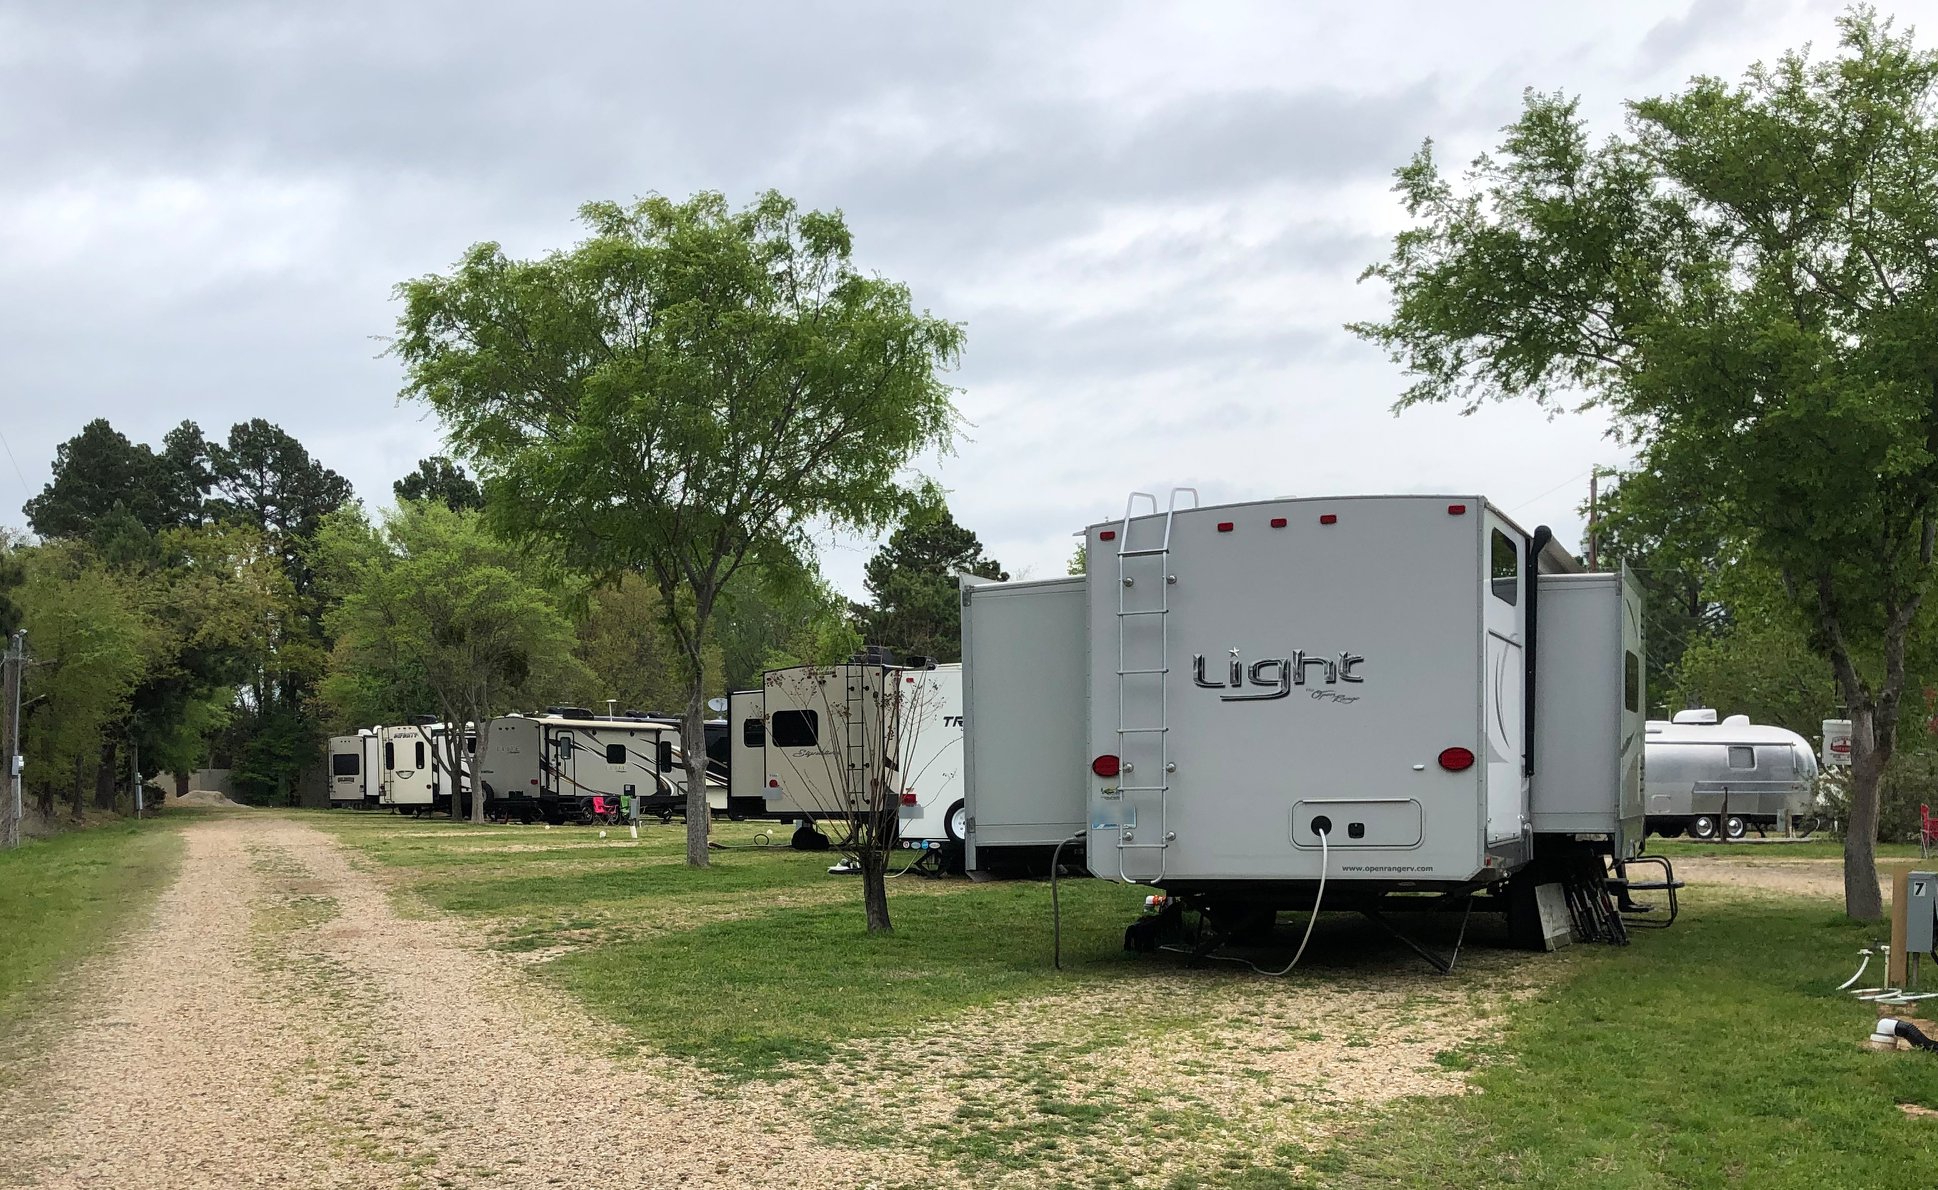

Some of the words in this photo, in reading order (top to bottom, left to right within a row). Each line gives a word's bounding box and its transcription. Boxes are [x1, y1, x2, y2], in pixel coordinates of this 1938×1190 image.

[1193, 646, 1364, 701] Light
[1341, 865, 1434, 874] www.openrangerv.com
[1914, 882, 1925, 896] 7
